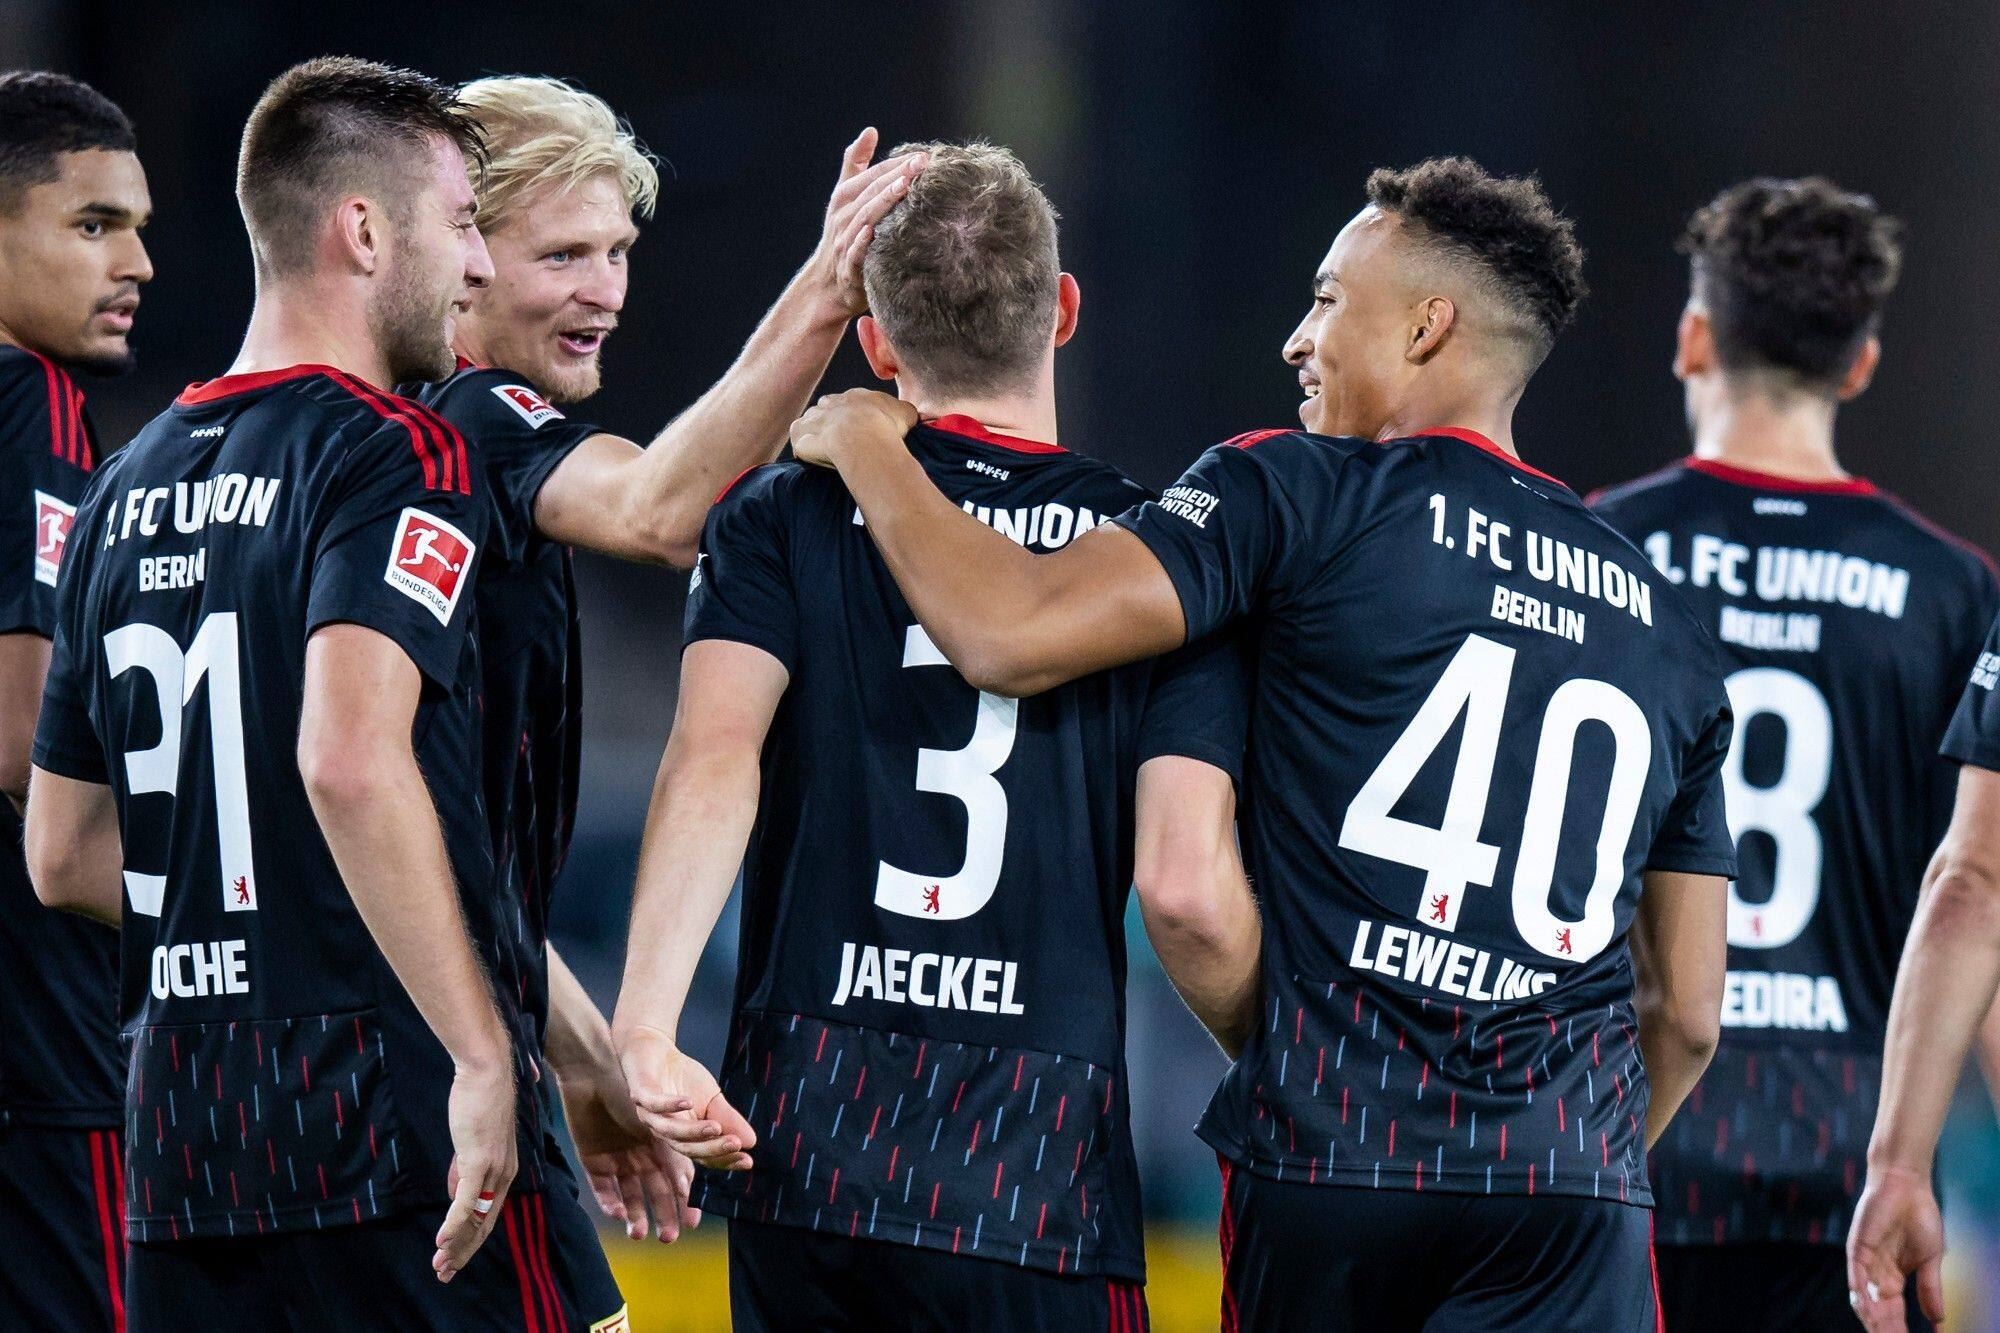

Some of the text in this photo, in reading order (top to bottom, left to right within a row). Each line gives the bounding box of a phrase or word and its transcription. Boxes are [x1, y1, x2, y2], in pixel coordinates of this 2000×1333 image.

[120, 487, 170, 540] FC
[391, 570, 447, 614] BUNDESLIGA
[1429, 493, 1653, 627] 1. FC UNION
[1644, 530, 1911, 620] 1. FC UNION
[1490, 584, 1586, 645] BERLIN
[1719, 604, 1822, 653] BERLIN
[103, 611, 259, 918] 31
[873, 623, 1019, 920] 3
[1338, 632, 1652, 963] 40
[1720, 666, 1834, 949] 8
[831, 942, 1025, 1015] JAECKEL
